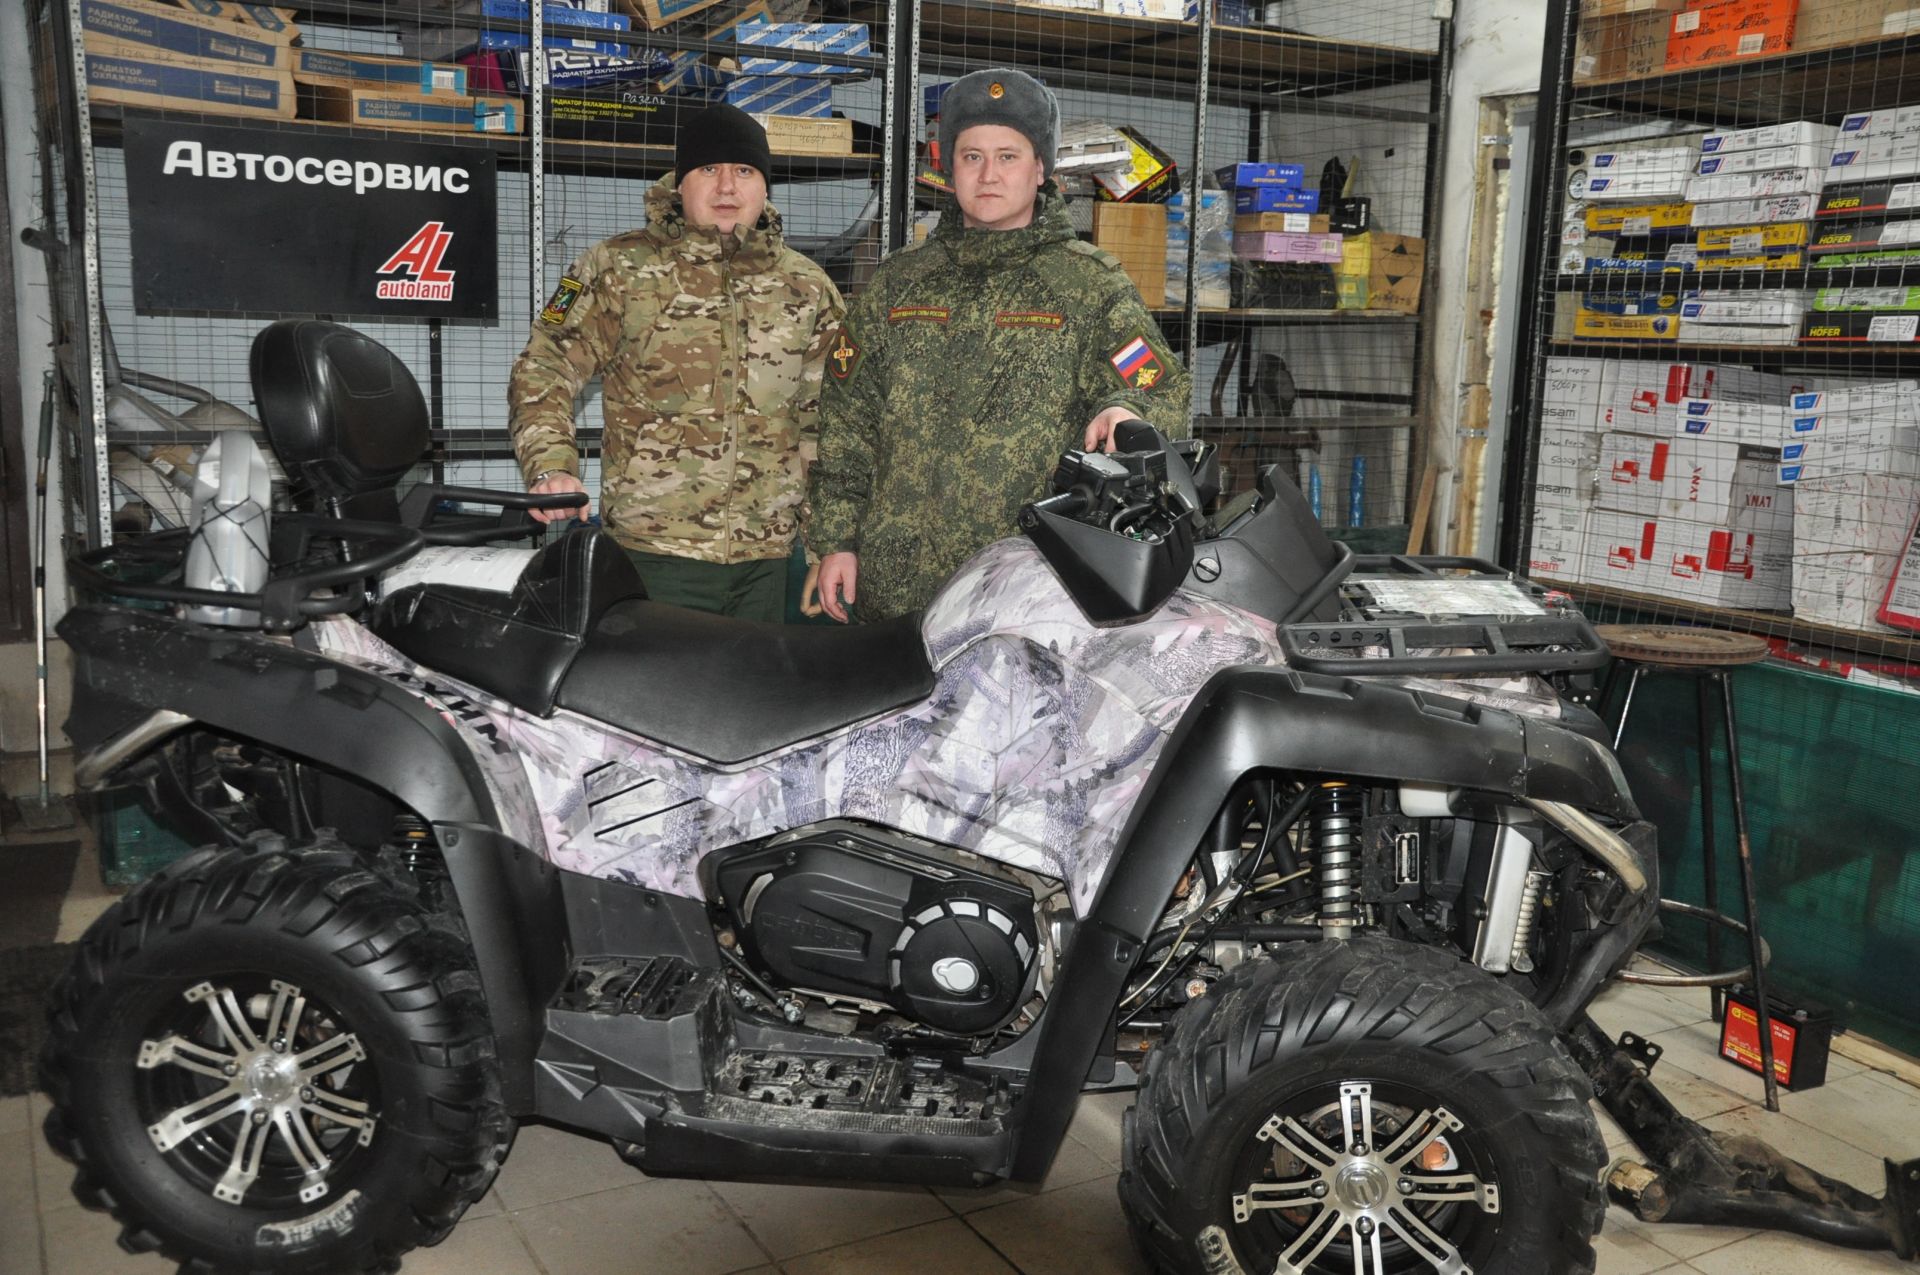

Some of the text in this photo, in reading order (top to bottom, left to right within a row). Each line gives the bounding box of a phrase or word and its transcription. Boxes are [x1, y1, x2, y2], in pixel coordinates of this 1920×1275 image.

[88, 7, 139, 25] РАДИАТОР
[87, 16, 153, 37] ОХЛАЖДЕНИЯ
[92, 62, 142, 76] РАДИАТОР
[309, 56, 346, 67] РАДИАТОР
[92, 71, 157, 87] ОХЛАЖДЕНИЯ
[365, 103, 400, 111] РАДИАТОР
[162, 140, 470, 194] Автосервис
[376, 221, 456, 283] AL
[377, 280, 453, 300] autoland
[1541, 407, 1576, 417] asam
[1536, 483, 1572, 495] asam
